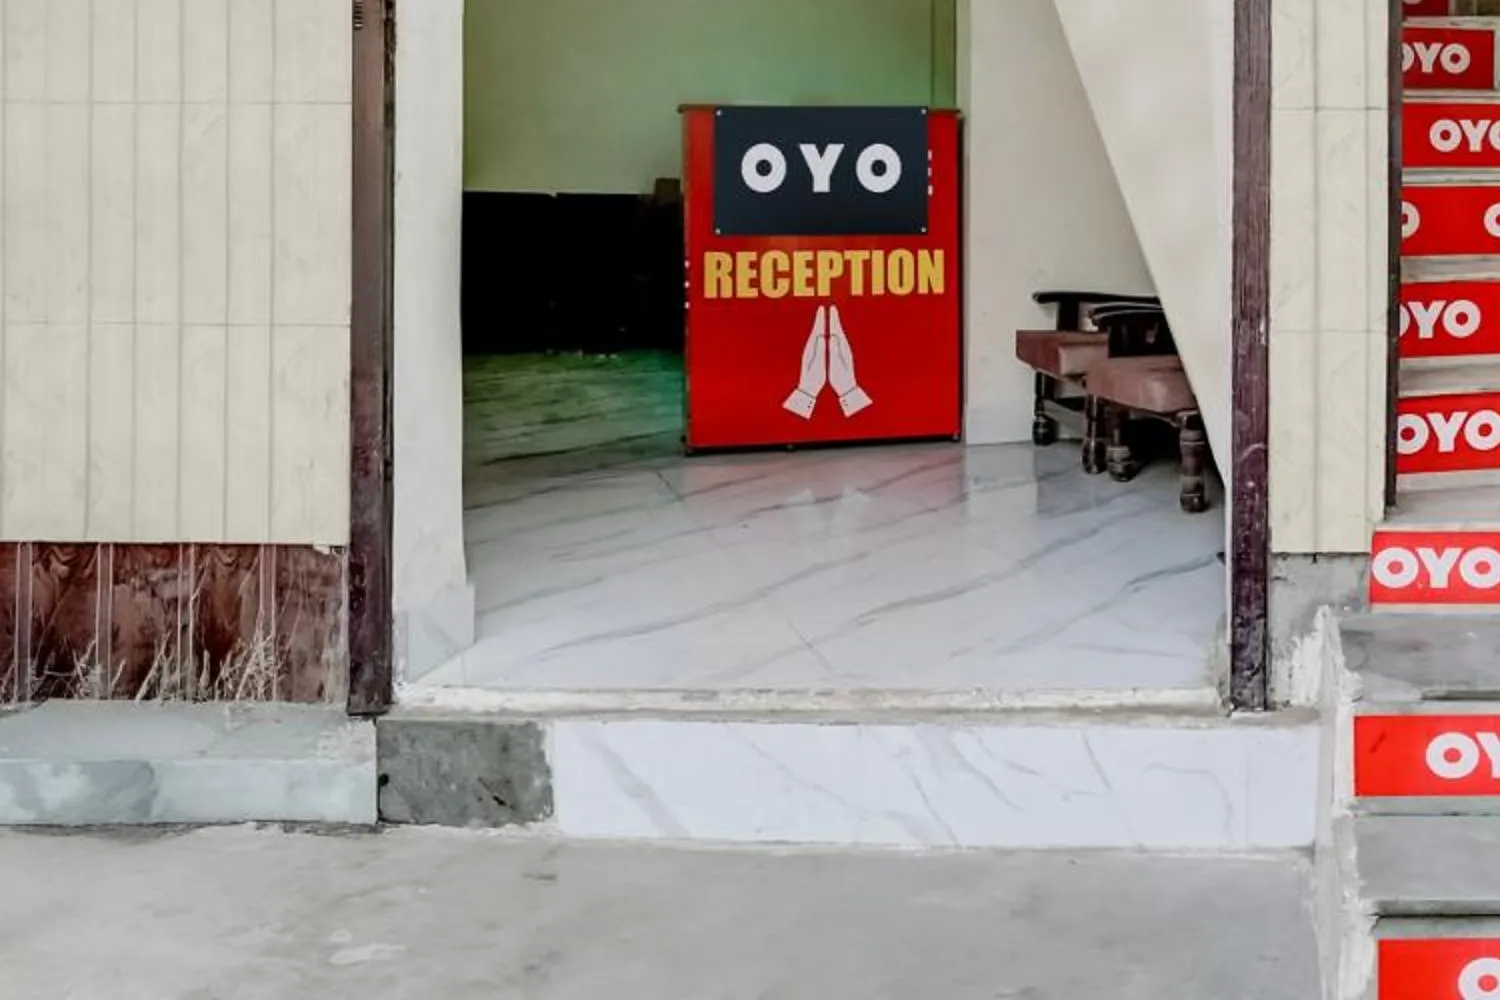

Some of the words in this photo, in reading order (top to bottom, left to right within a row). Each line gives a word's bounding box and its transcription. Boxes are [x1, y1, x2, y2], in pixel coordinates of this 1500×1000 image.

[742, 144, 901, 192] OYO
[705, 250, 944, 297] RECEPTION
[1400, 300, 1480, 338] YO
